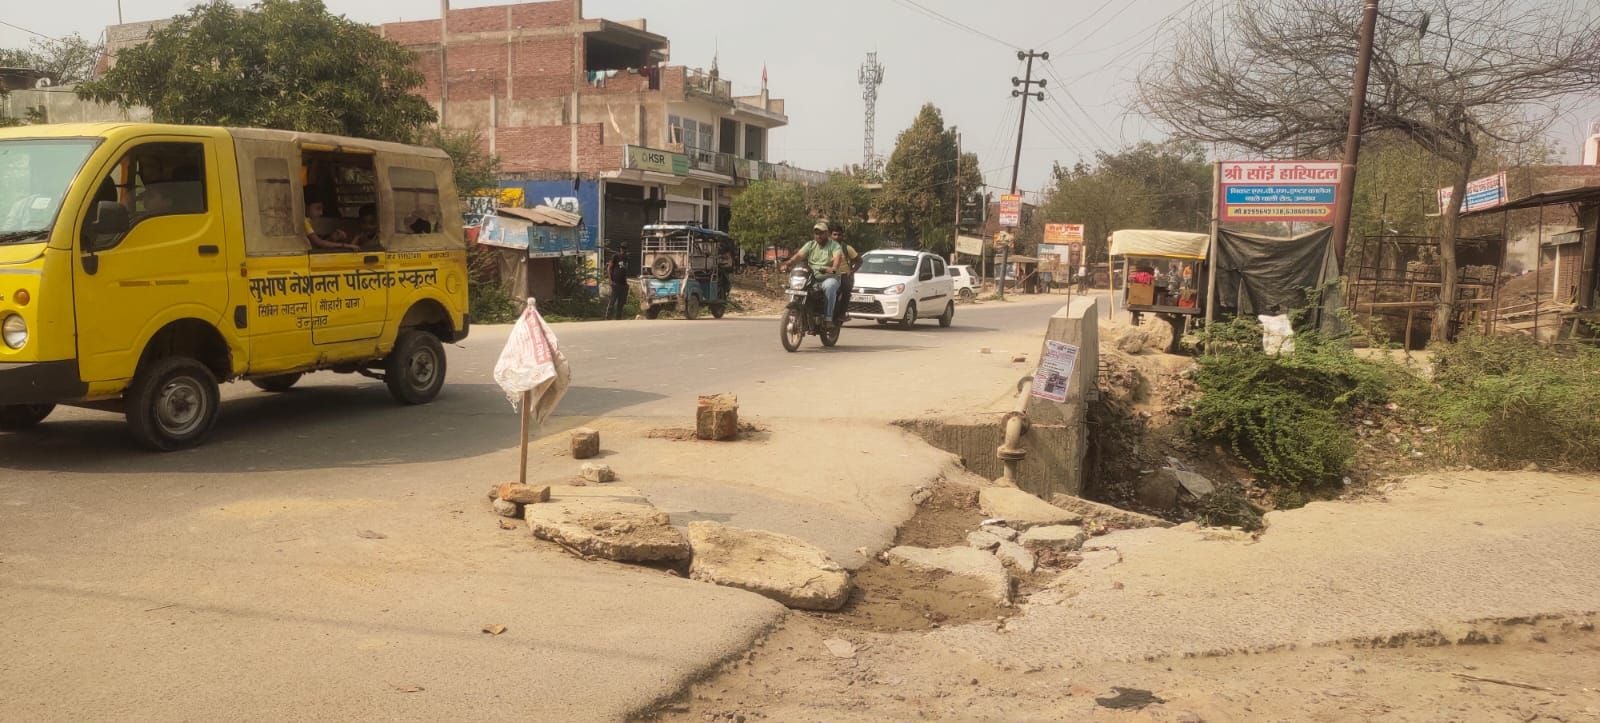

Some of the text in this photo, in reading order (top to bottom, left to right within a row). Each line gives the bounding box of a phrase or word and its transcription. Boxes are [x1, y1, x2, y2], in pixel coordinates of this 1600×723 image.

[648, 153, 665, 165] KSR
[1224, 165, 1242, 180] श्री
[249, 268, 438, 302] सुभाष नेशनल पब्लिक स्कूल
